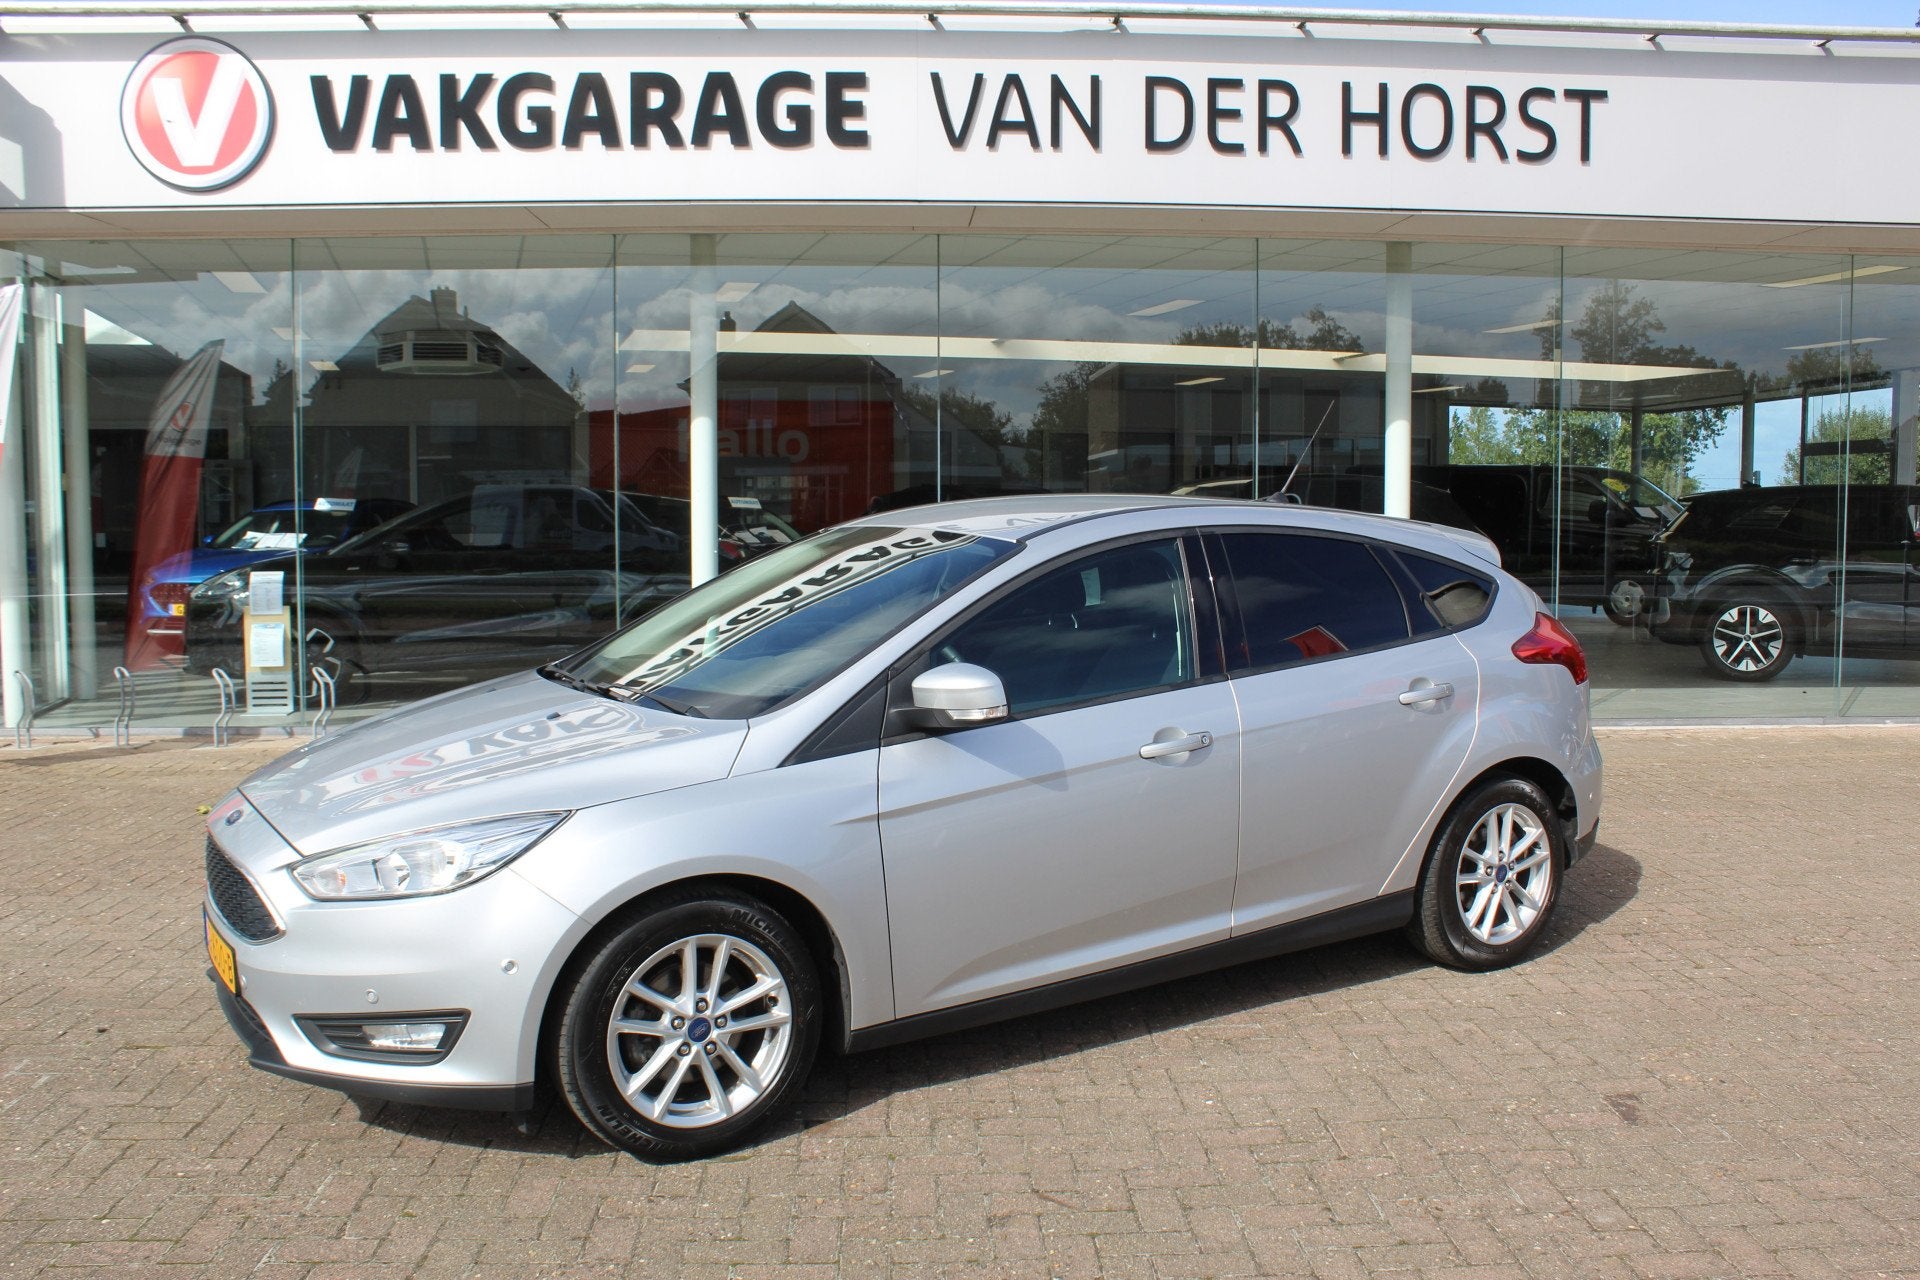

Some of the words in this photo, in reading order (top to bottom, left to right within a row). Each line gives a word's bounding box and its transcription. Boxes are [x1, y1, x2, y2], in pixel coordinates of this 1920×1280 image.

[311, 71, 869, 151] VAKGARAGE
[930, 72, 1101, 151] VAN
[1144, 76, 1301, 156] DER
[1341, 82, 1609, 163] HORST
